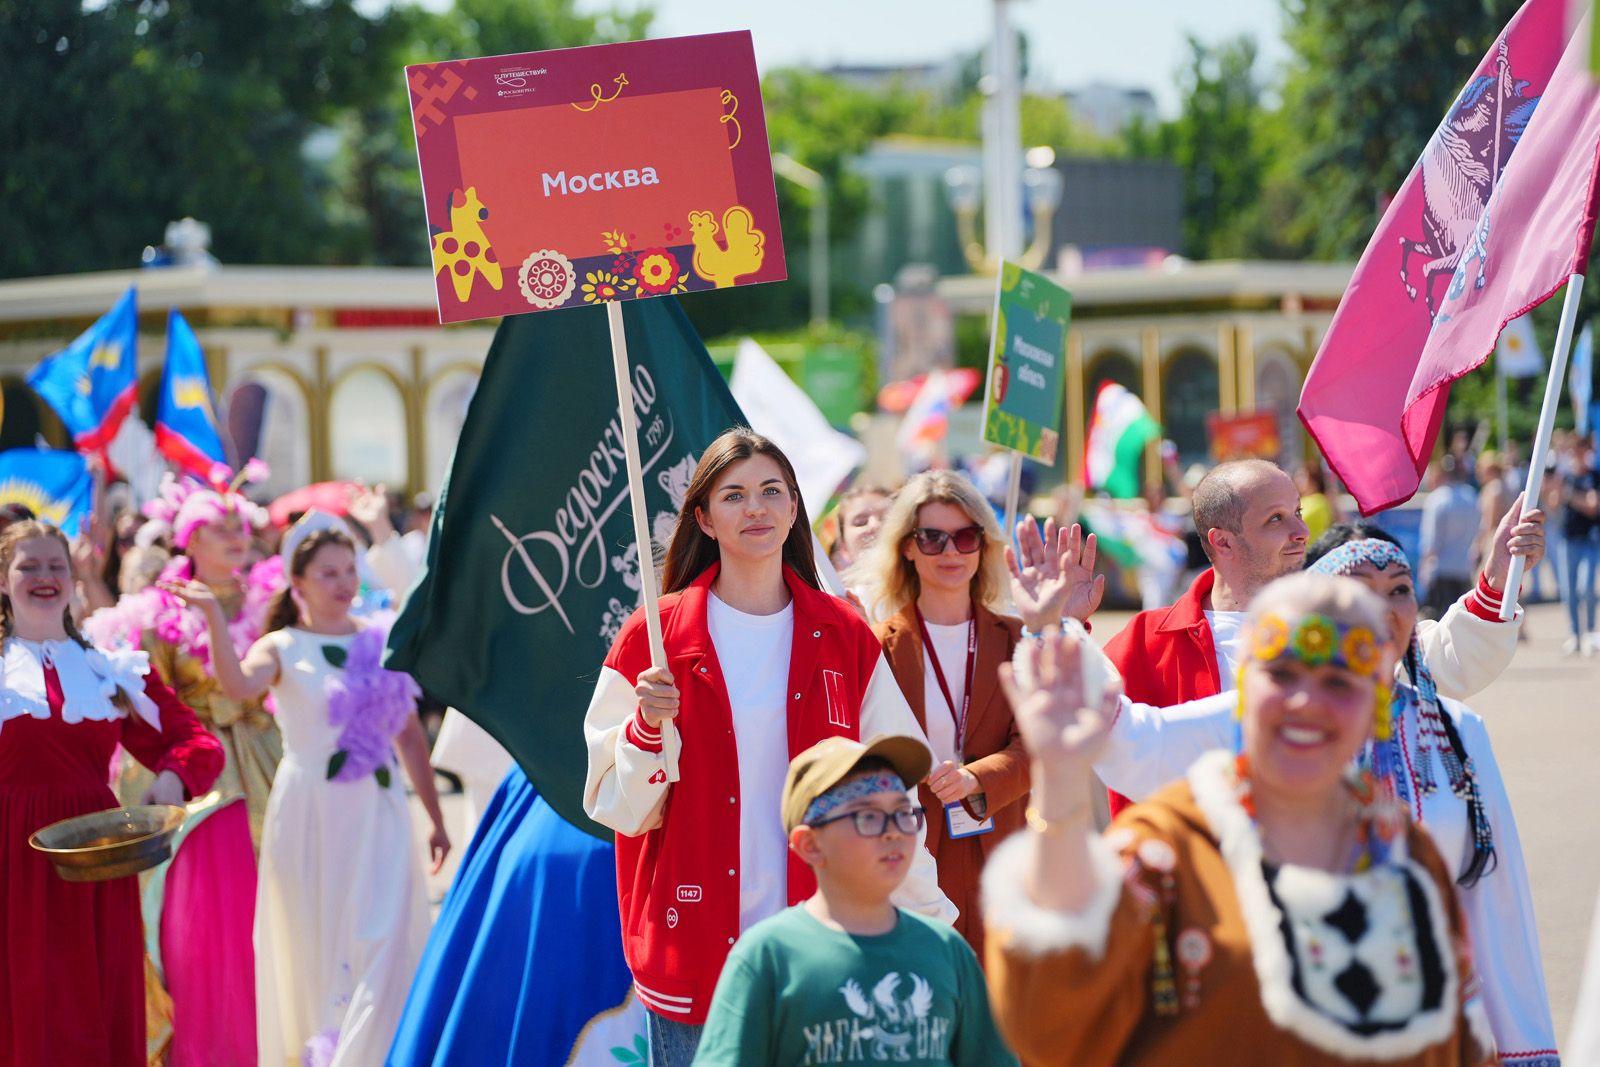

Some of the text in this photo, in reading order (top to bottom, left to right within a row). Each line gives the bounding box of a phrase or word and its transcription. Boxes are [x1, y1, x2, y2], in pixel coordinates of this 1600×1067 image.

[541, 166, 660, 197] Москва
[645, 414, 665, 446] 1795
[680, 889, 698, 898] 1147
